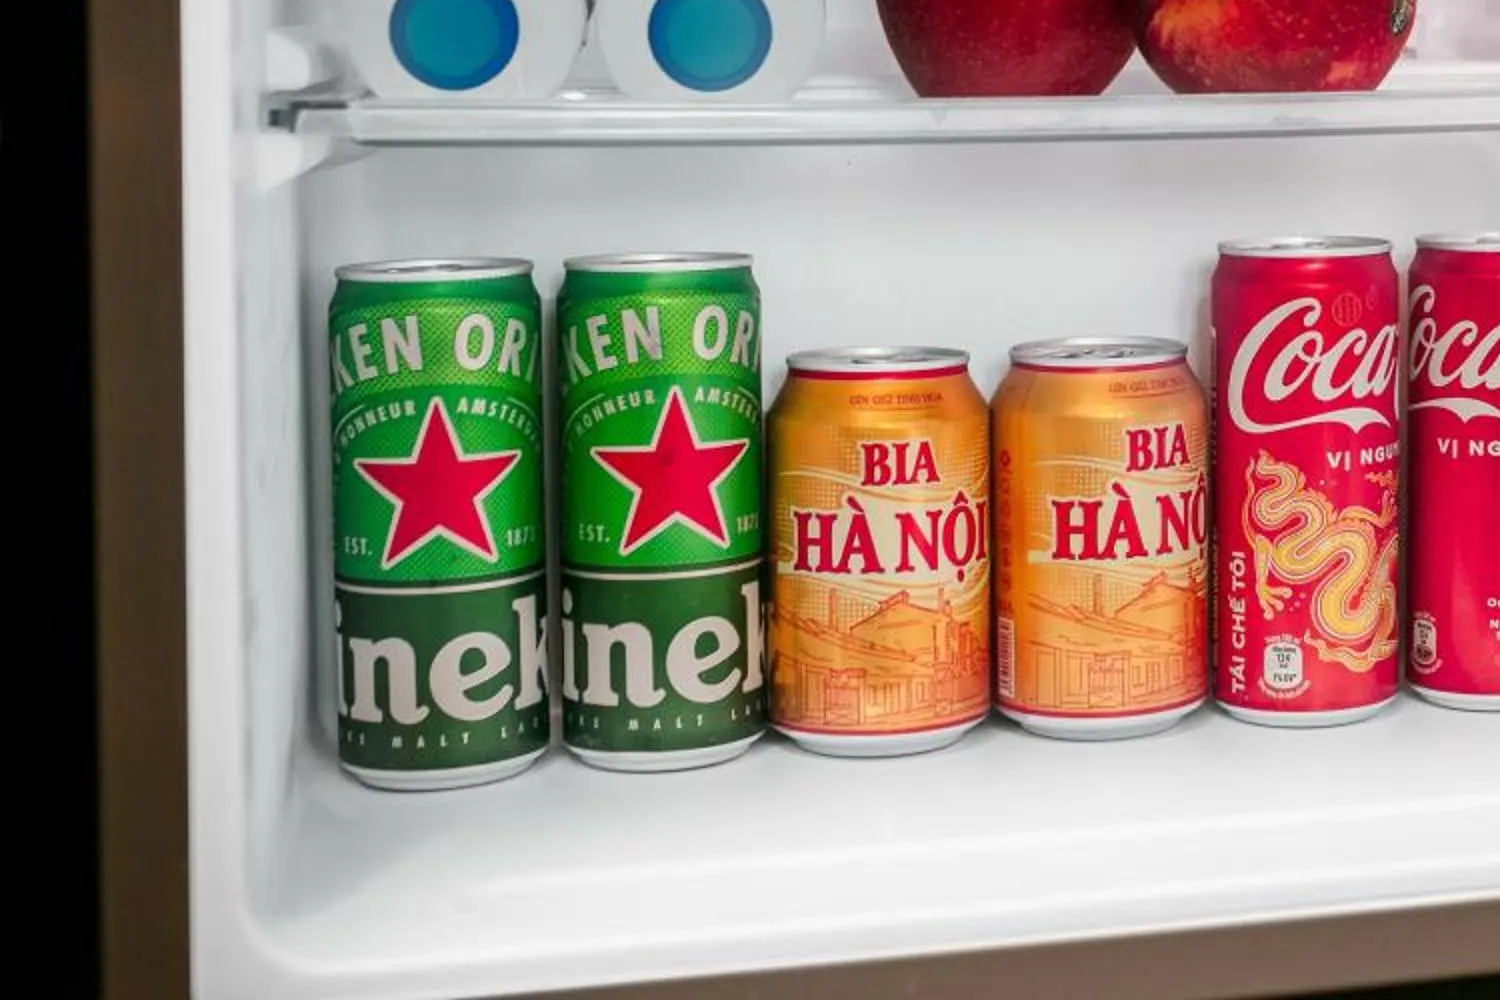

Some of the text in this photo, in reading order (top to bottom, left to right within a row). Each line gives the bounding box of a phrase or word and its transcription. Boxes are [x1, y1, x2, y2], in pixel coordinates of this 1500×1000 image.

[861, 441, 940, 486] BIA
[1126, 424, 1190, 472] BIA
[793, 496, 884, 574] HÀ
[895, 490, 988, 582] NỘI
[1052, 482, 1148, 560] HÀ
